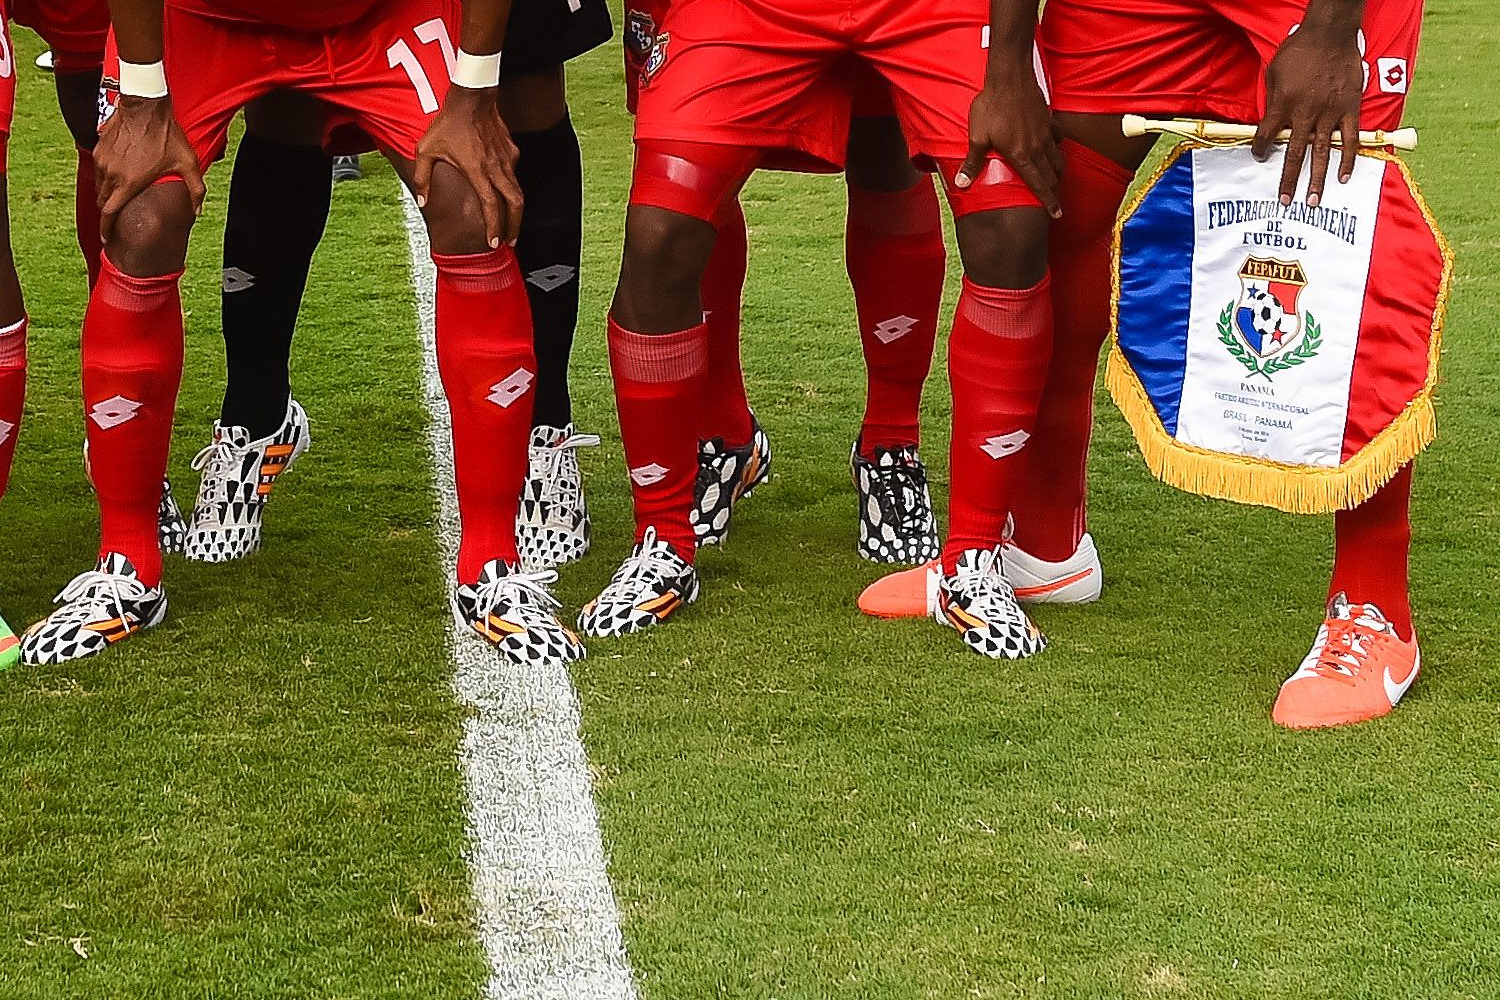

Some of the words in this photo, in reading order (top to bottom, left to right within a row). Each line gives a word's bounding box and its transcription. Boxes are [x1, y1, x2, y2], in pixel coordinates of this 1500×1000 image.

[387, 18, 458, 114] 17
[1267, 220, 1283, 233] DE
[1242, 232, 1308, 251] FUTBOL
